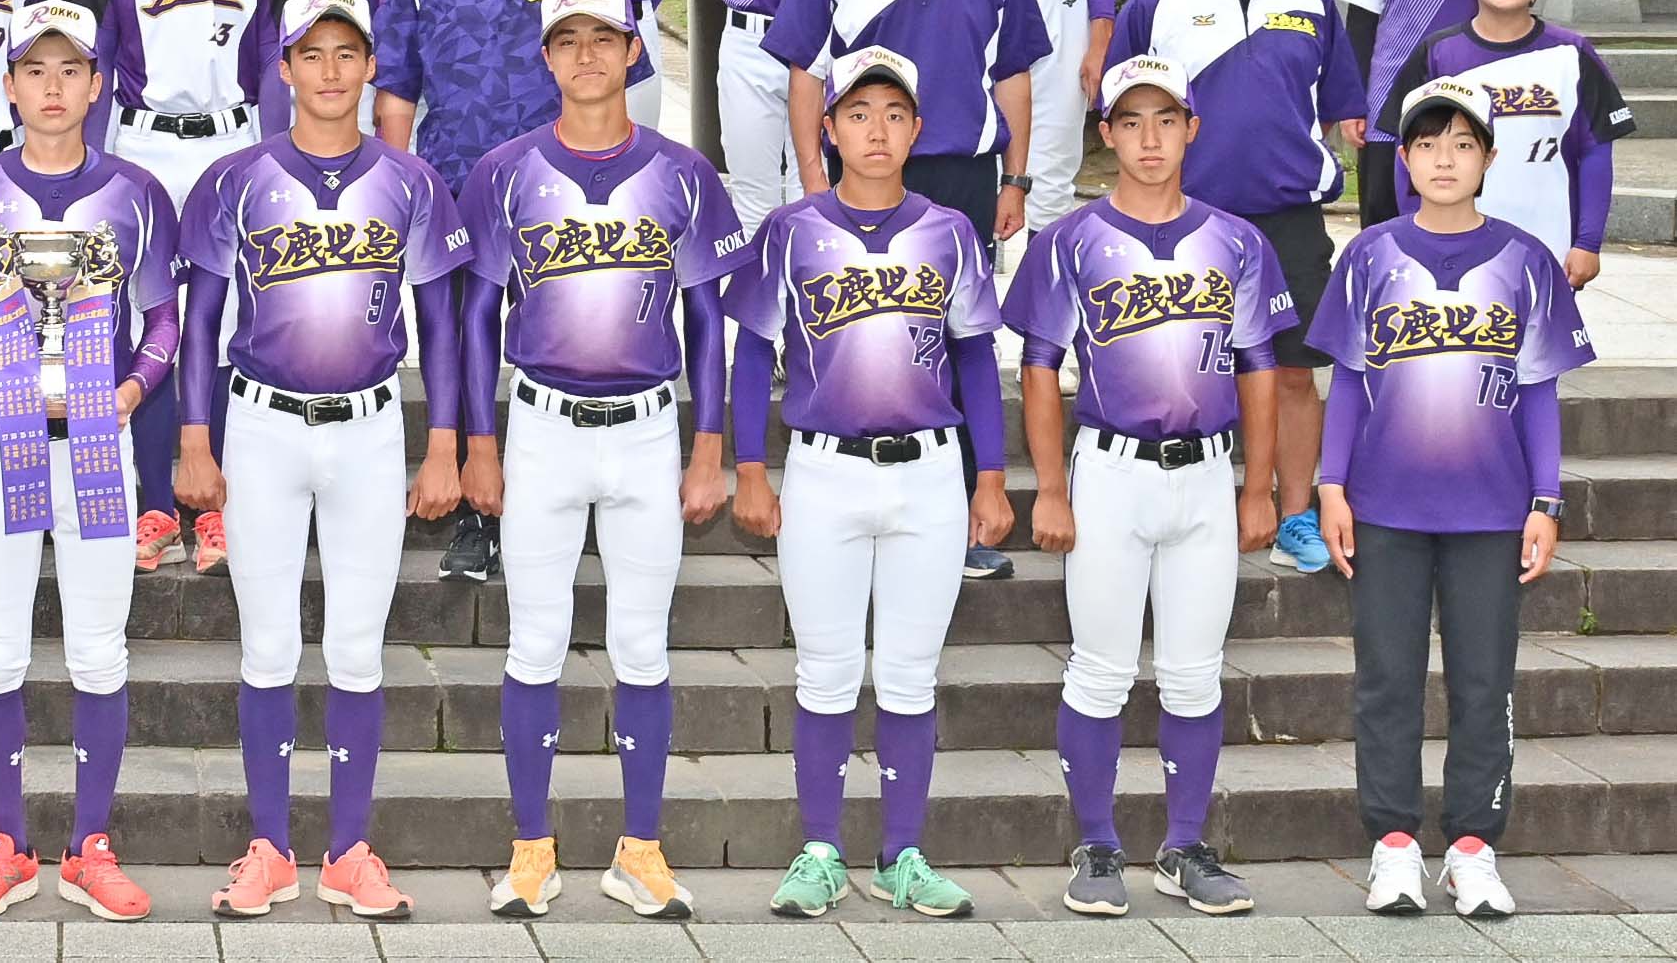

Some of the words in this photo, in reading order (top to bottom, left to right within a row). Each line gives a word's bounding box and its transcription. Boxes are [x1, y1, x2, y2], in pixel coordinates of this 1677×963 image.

[24, 6, 80, 29] ROKKO
[849, 50, 903, 73] ROKKO
[1114, 59, 1169, 86] ROKKO
[1525, 137, 1558, 163] 17
[248, 217, 401, 292] 工鹿児島
[519, 215, 675, 290] 工鹿児島
[366, 280, 388, 325] 9
[635, 280, 657, 324] 1
[801, 262, 946, 340] 工鹿児島
[1089, 266, 1234, 347] 工鹿児島
[1364, 299, 1520, 370] 工鹿児島
